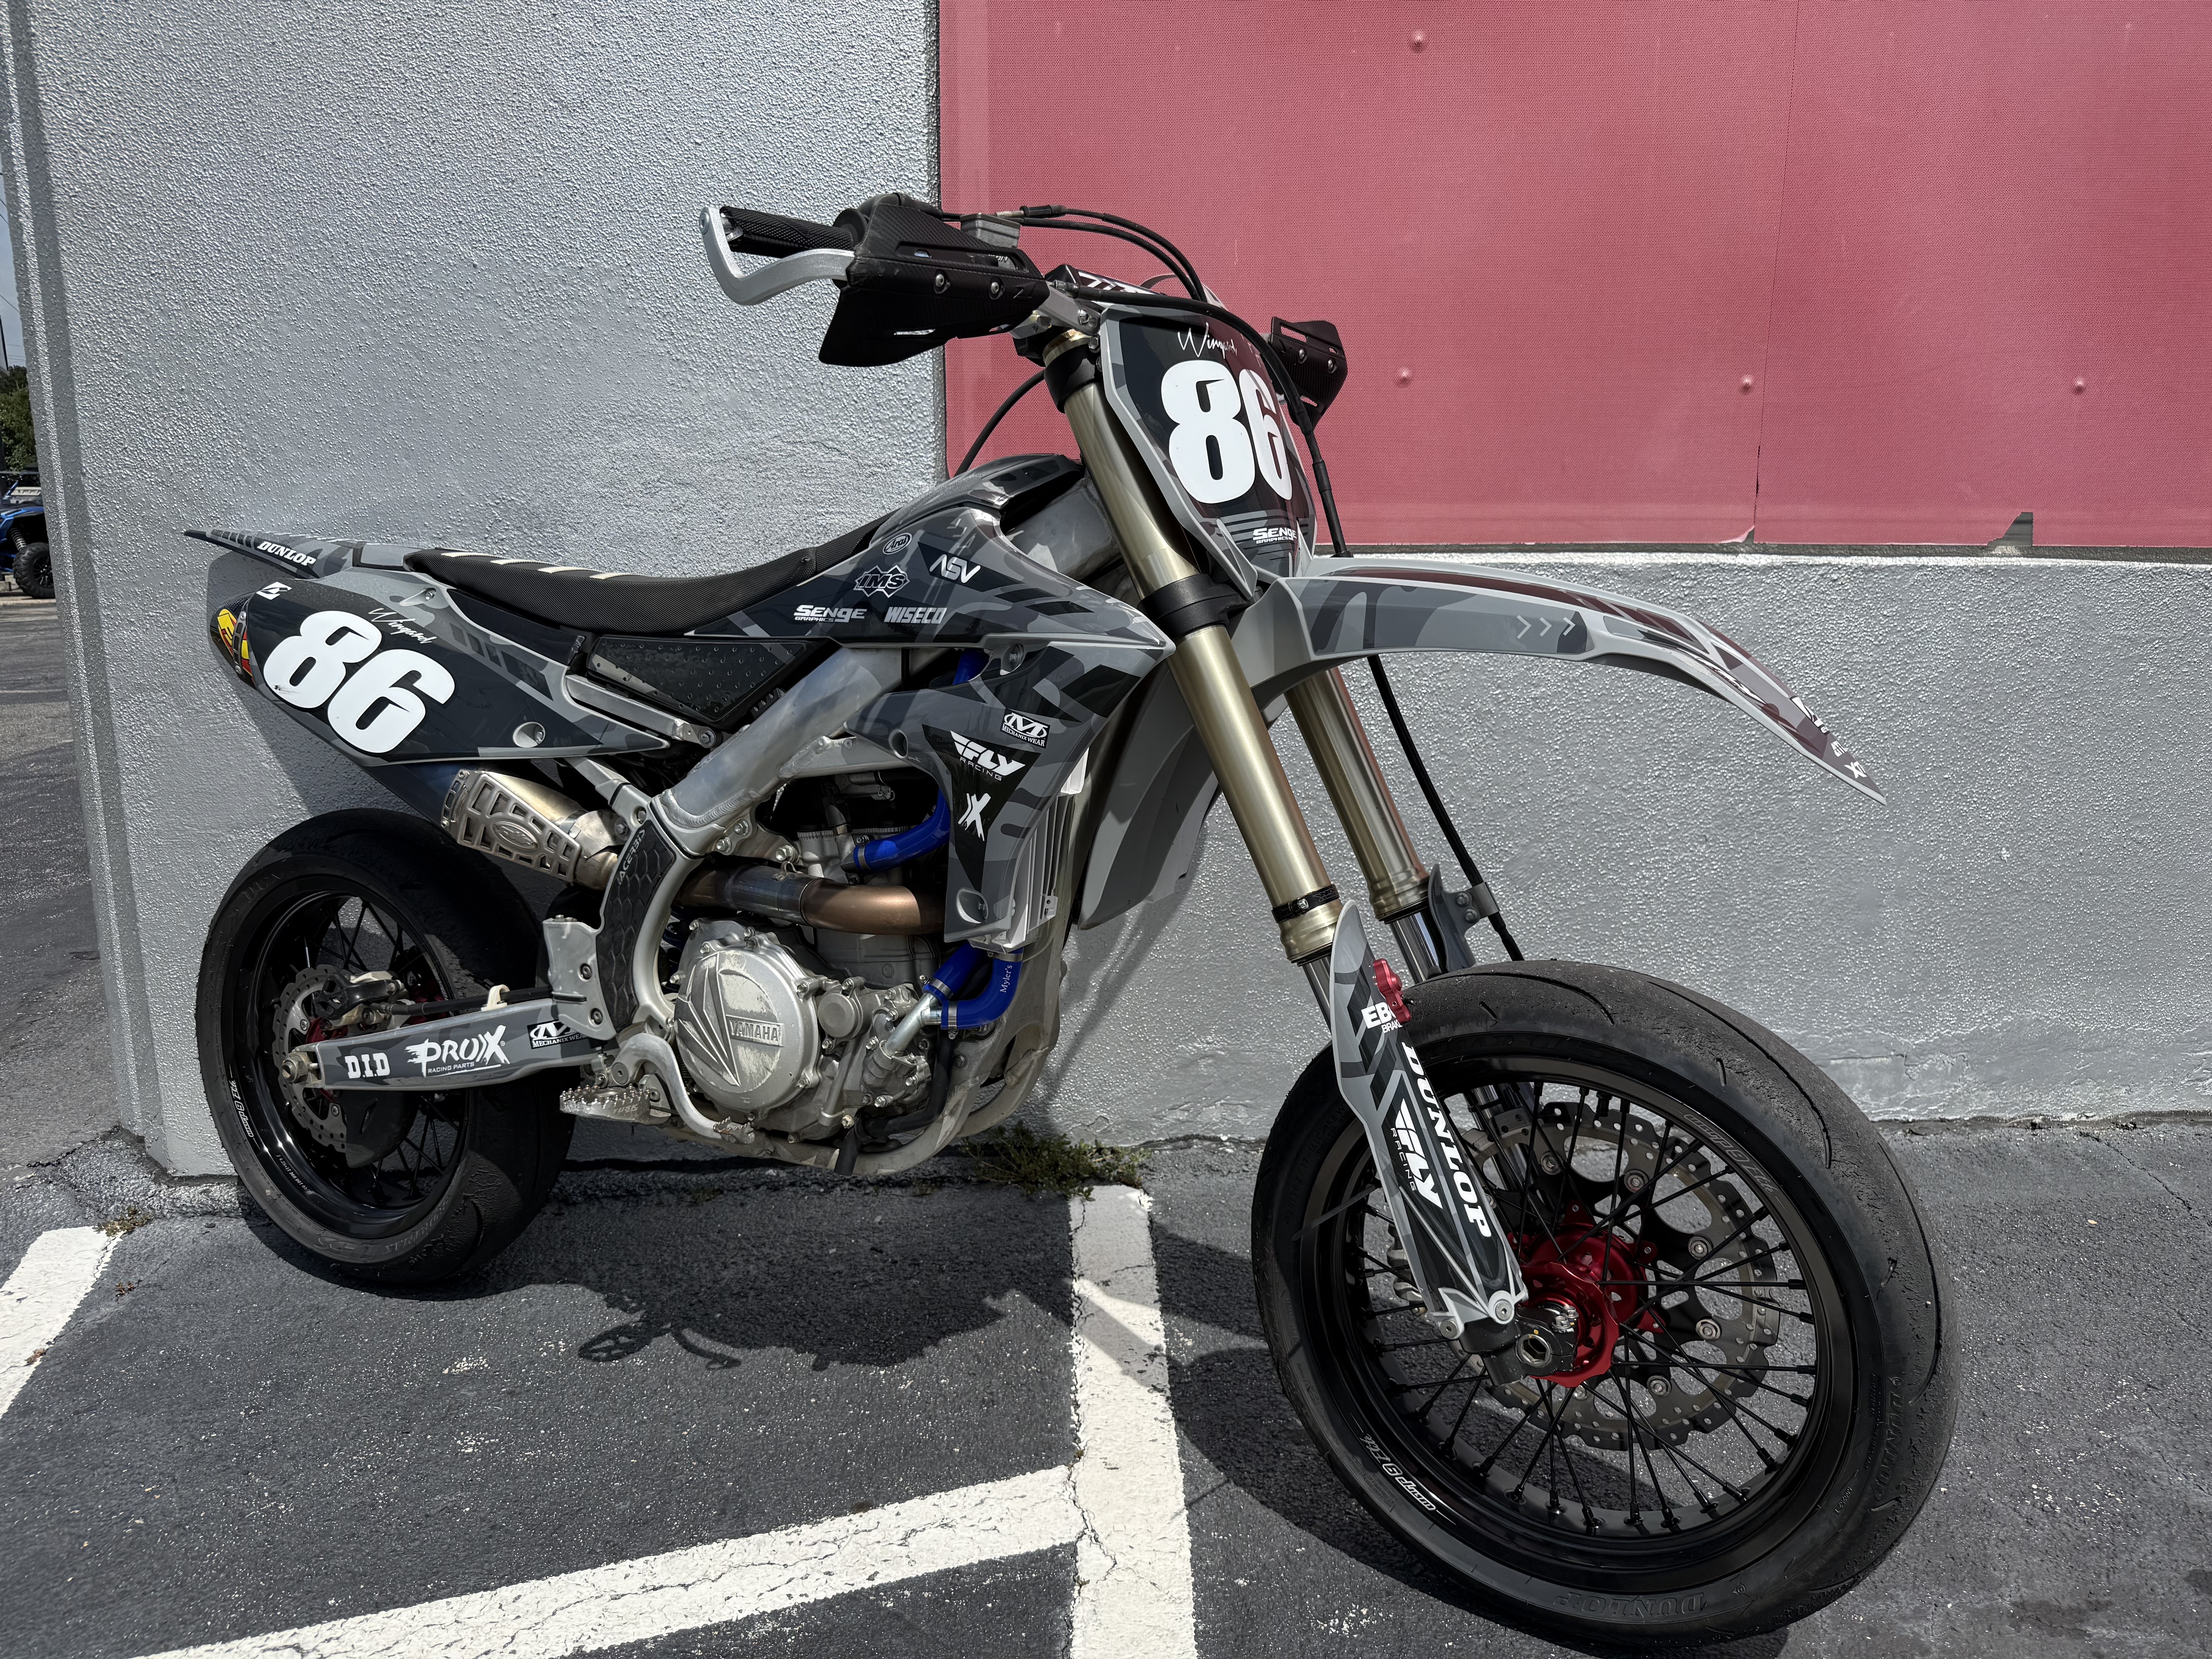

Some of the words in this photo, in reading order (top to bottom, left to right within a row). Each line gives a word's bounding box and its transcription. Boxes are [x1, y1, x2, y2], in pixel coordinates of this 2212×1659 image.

[1161, 360, 1291, 503] 86
[257, 541, 316, 566] DUNLOP
[886, 535, 908, 551] Arai
[857, 574, 906, 589] IMS
[929, 554, 981, 583] ASV
[884, 607, 947, 624] WISECO
[264, 611, 455, 753] 86
[1001, 723, 1027, 740] MECHANIX
[1027, 737, 1045, 747] WEAR
[950, 730, 1026, 776] FLY
[960, 757, 1002, 781] RACING
[1361, 1002, 1397, 1029] EB
[532, 1037, 569, 1048] MECHANIX
[729, 1020, 780, 1044] YAMAHA
[345, 1053, 391, 1079] D.I.D
[428, 1064, 452, 1073] RACING
[453, 1061, 475, 1070] PARTS
[1401, 1042, 1492, 1237] DUNLOP
[1391, 1128, 1416, 1191] RACING
[1395, 1099, 1443, 1209] FLY
[1553, 1592, 1704, 1619] DUNLOP
